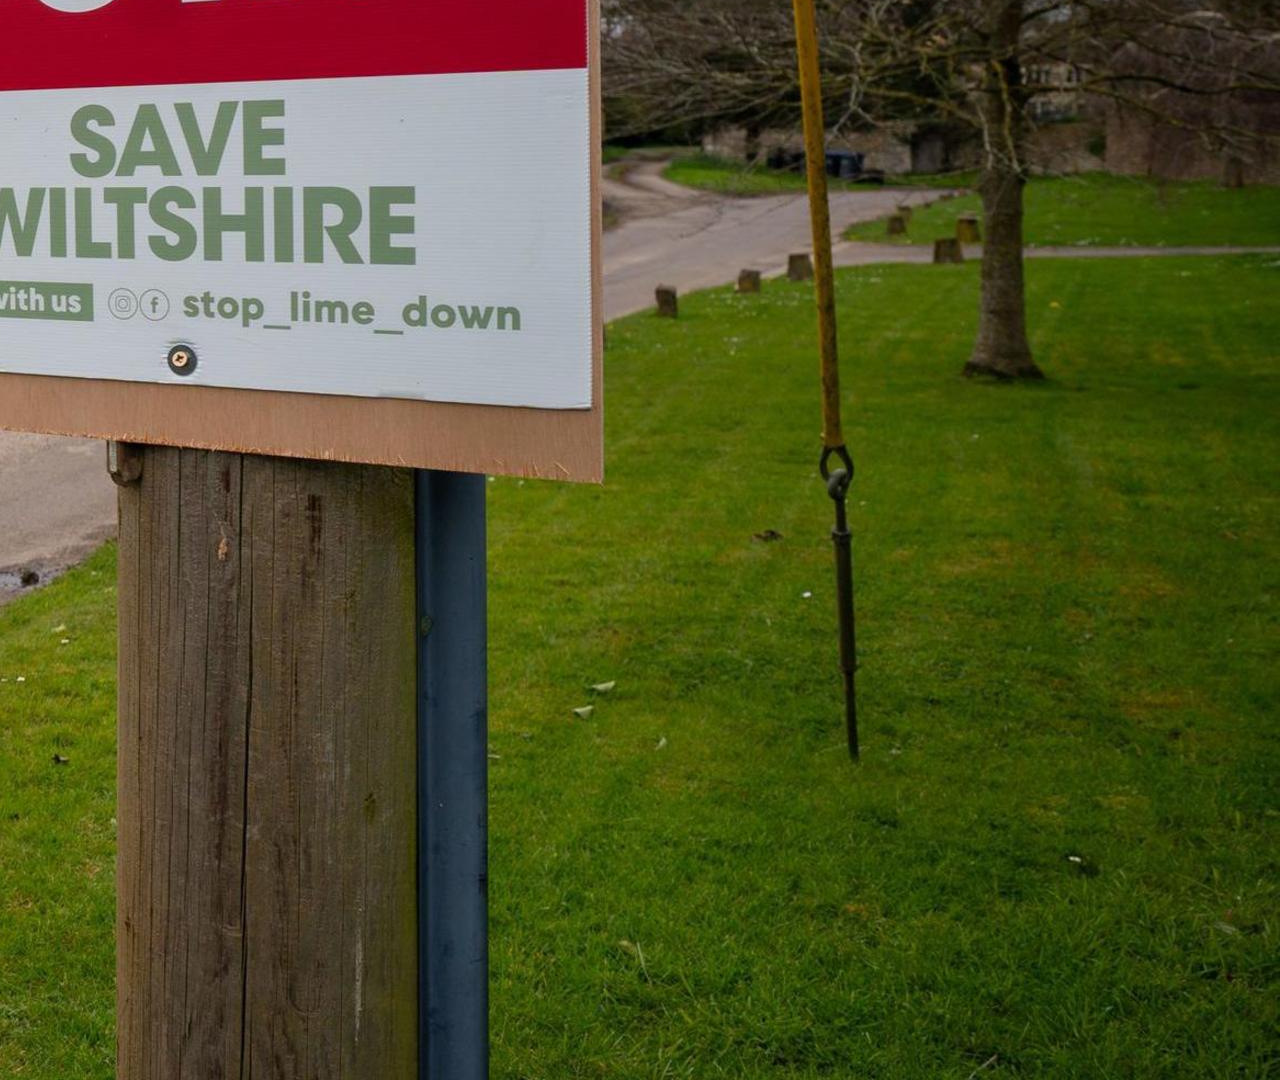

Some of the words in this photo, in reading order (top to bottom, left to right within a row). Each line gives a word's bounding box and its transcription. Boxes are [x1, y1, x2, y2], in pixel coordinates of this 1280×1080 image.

[69, 99, 286, 178] SAVE
[51, 295, 82, 313] us
[183, 291, 521, 335] stop_lime_down
